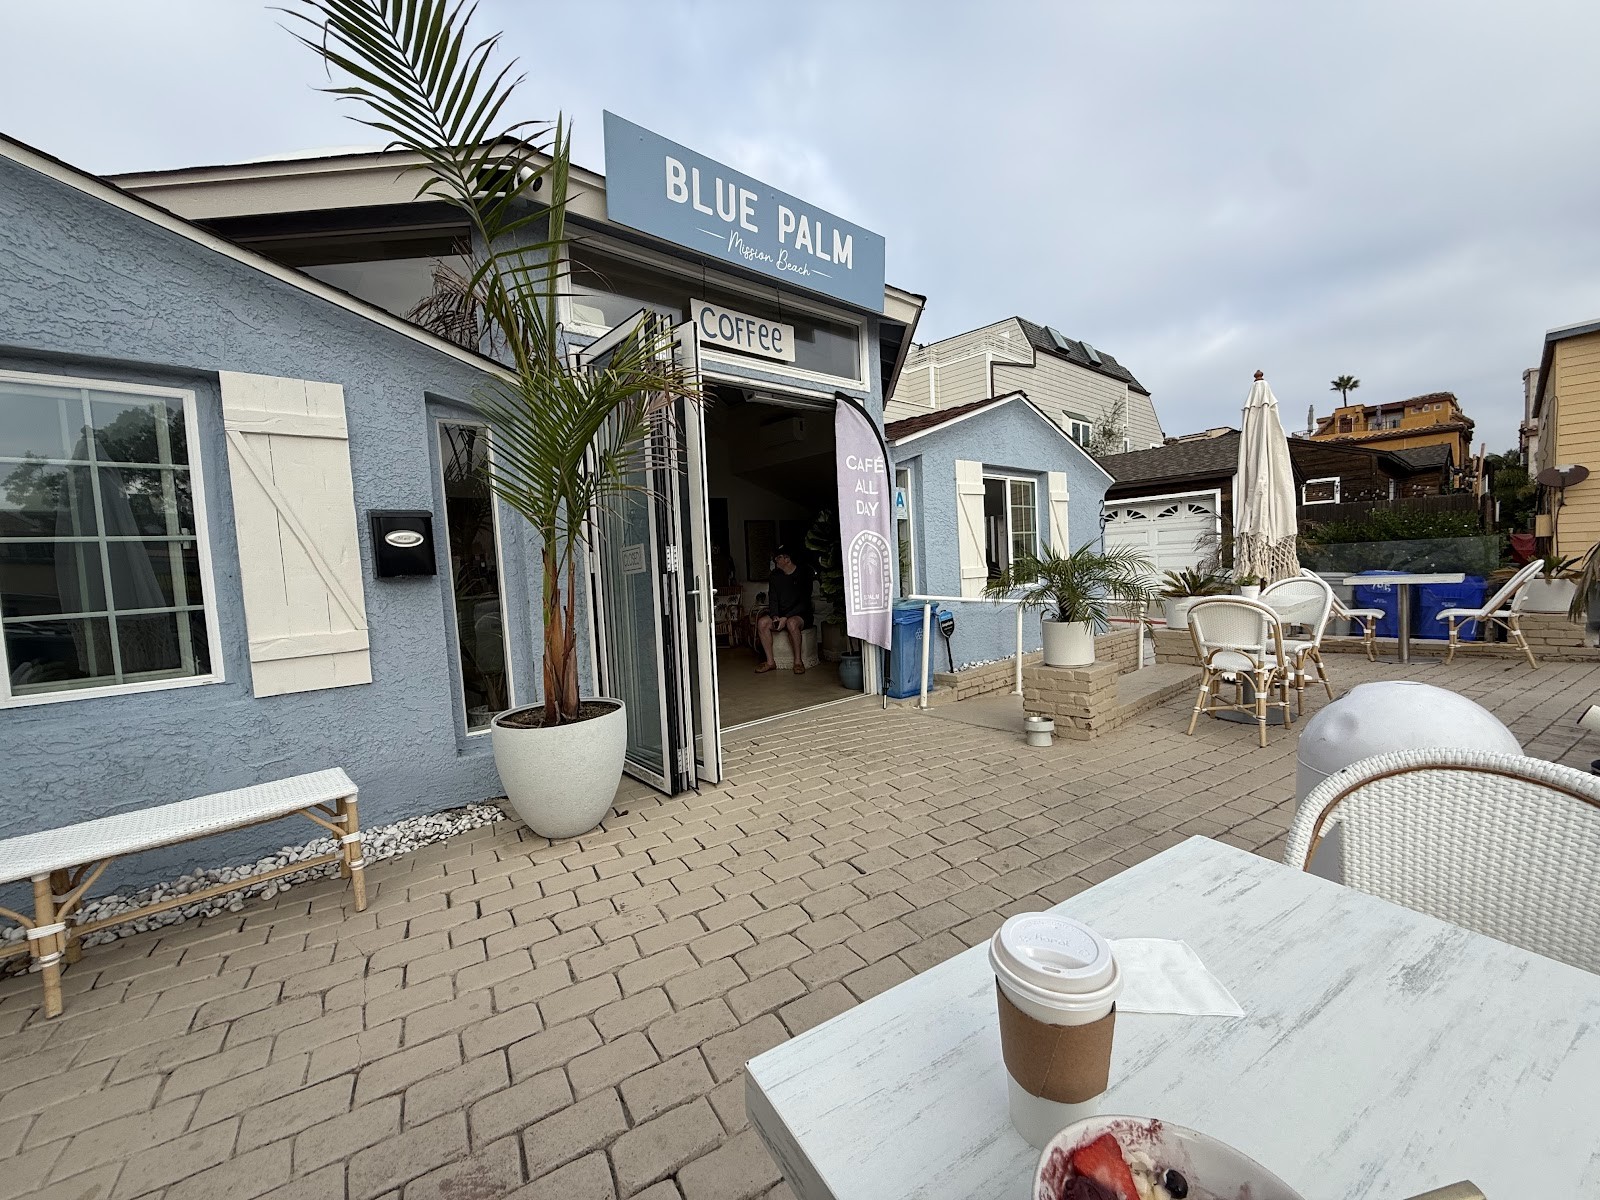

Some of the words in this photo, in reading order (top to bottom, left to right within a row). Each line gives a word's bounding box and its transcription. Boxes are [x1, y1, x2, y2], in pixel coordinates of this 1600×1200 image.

[665, 155, 759, 233] BLUE
[778, 204, 853, 270] PALM
[727, 229, 773, 263] Mission
[775, 248, 811, 276] Beach
[846, 455, 884, 473] CAFÉ
[854, 477, 879, 495] ALL
[896, 491, 905, 507] A
[856, 500, 880, 518] DAY
